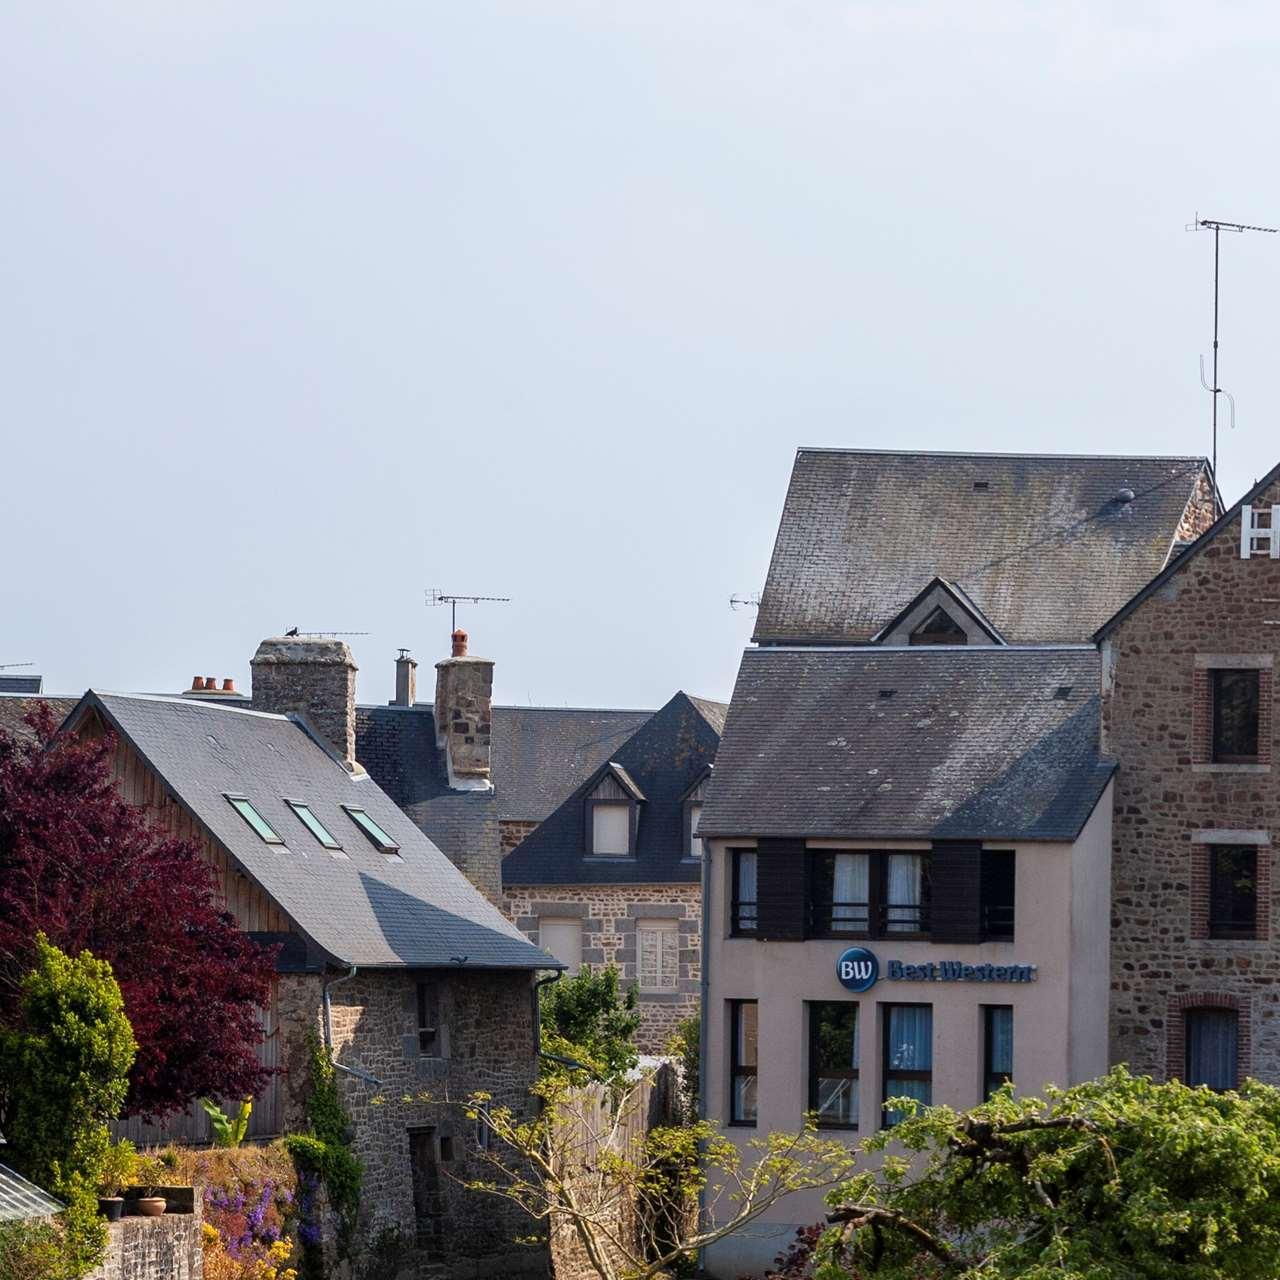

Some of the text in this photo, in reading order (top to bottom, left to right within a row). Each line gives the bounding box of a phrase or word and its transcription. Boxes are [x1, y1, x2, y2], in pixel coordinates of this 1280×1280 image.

[841, 961, 873, 980] BW
[887, 960, 1033, 983] Best Western
